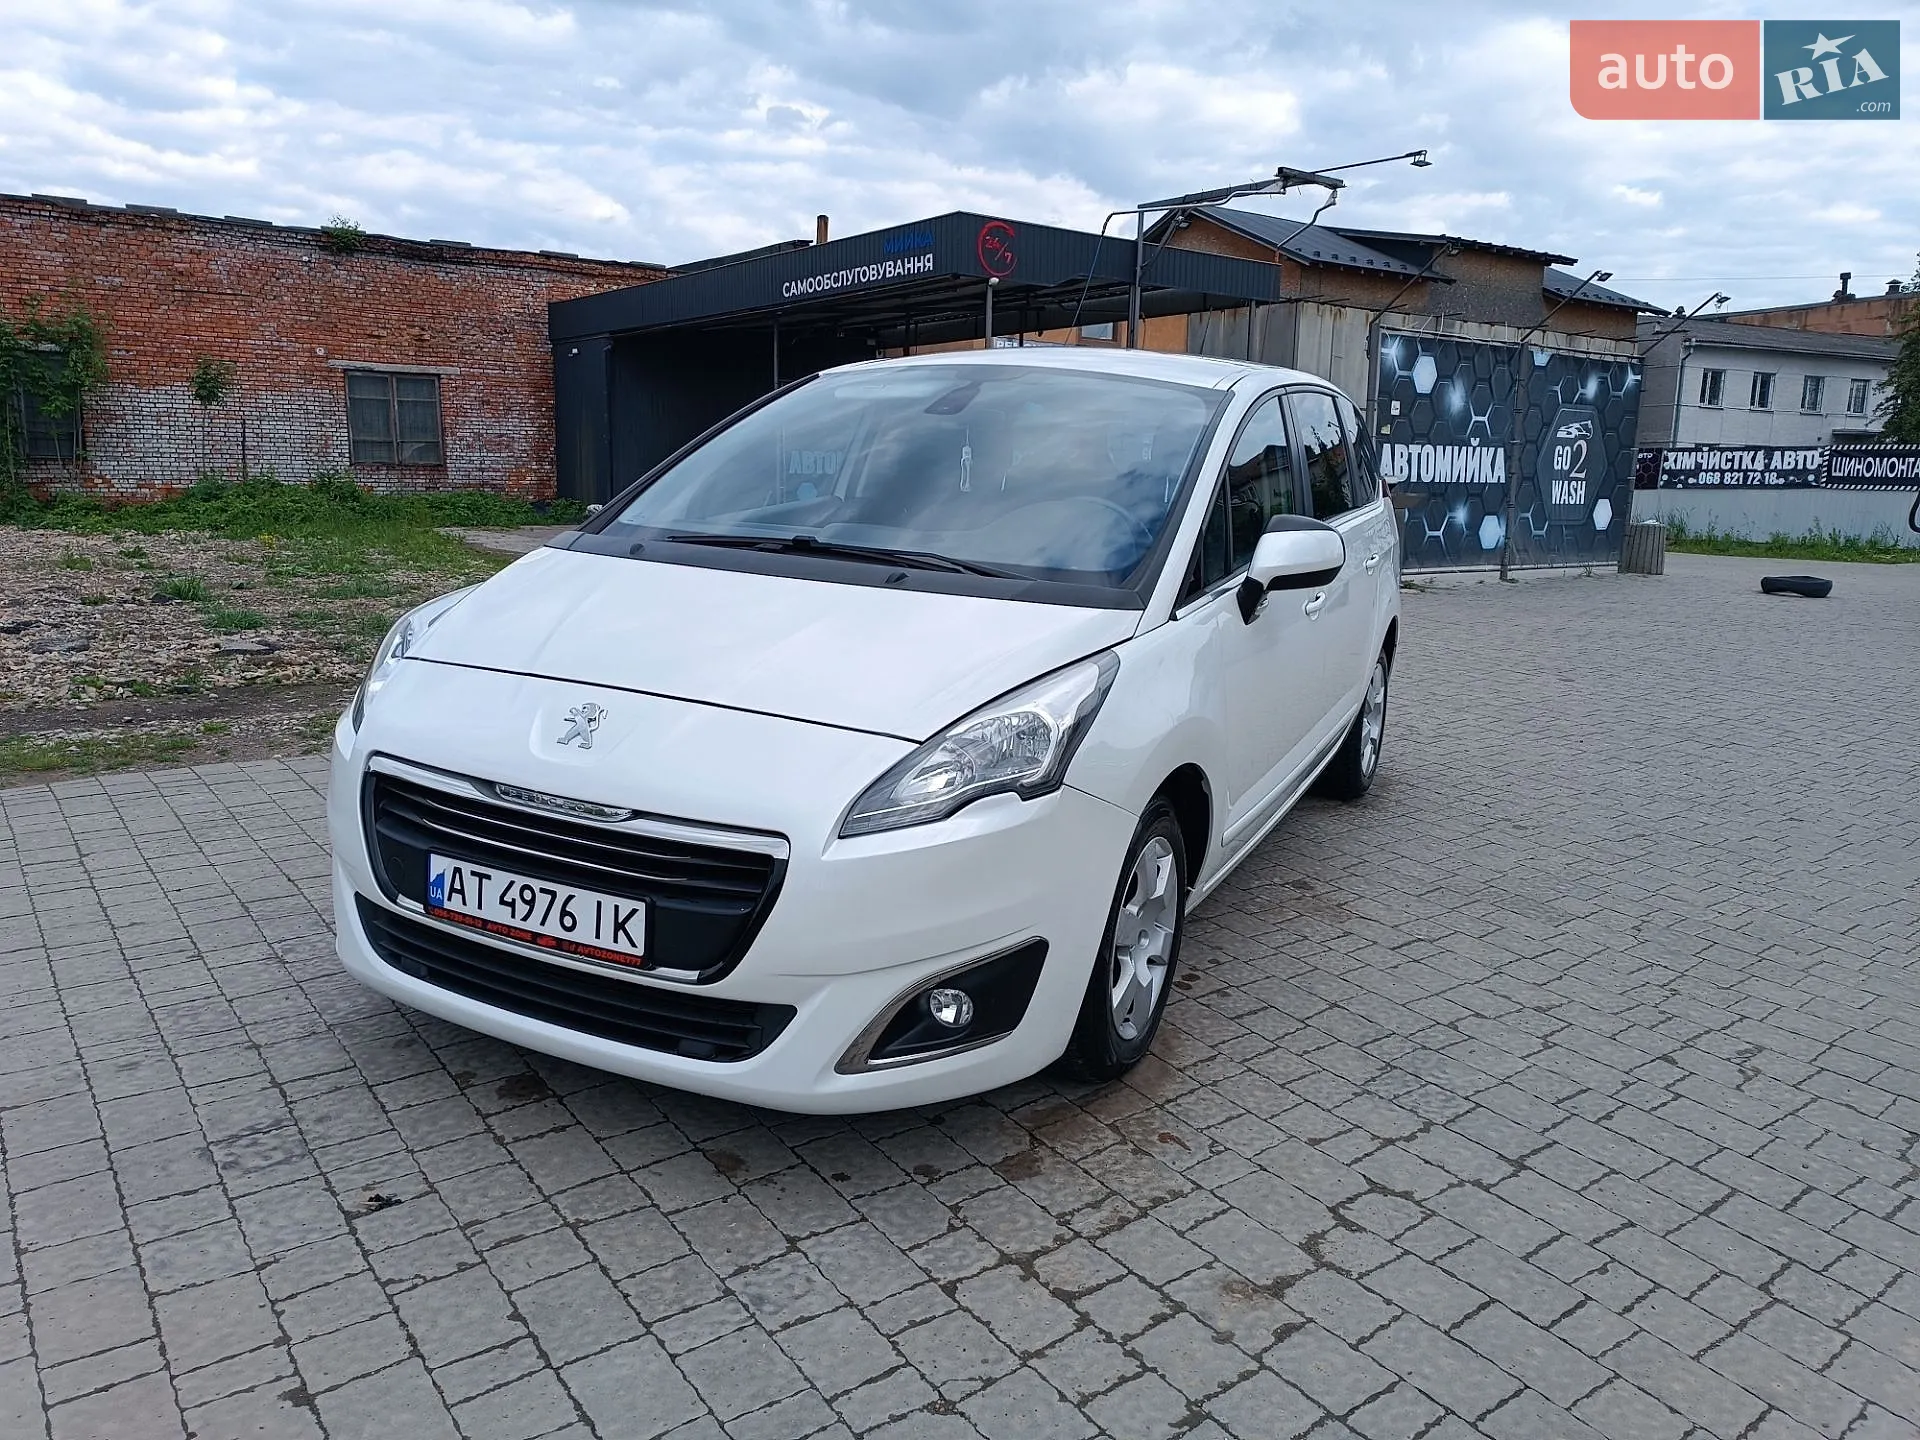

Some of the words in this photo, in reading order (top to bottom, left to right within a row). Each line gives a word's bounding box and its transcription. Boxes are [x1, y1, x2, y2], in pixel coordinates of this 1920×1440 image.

[882, 229, 935, 254] МИЙКА
[782, 253, 934, 298] САМООБСЛУГОВУВАННЯ
[789, 450, 843, 475] АВТО
[1380, 437, 1506, 484] АВТОМИЙКА
[1553, 445, 1572, 471] GO
[1569, 439, 1588, 479] 2
[1769, 450, 1820, 470] АВТО
[1698, 471, 1721, 485] 068
[1723, 471, 1744, 485] 821
[1746, 471, 1761, 485] 72
[1764, 471, 1778, 485] 18
[1551, 480, 1587, 505] WASH
[430, 885, 443, 900] UA
[447, 866, 492, 911] AT
[498, 880, 578, 932] 4976
[594, 900, 640, 949] IK
